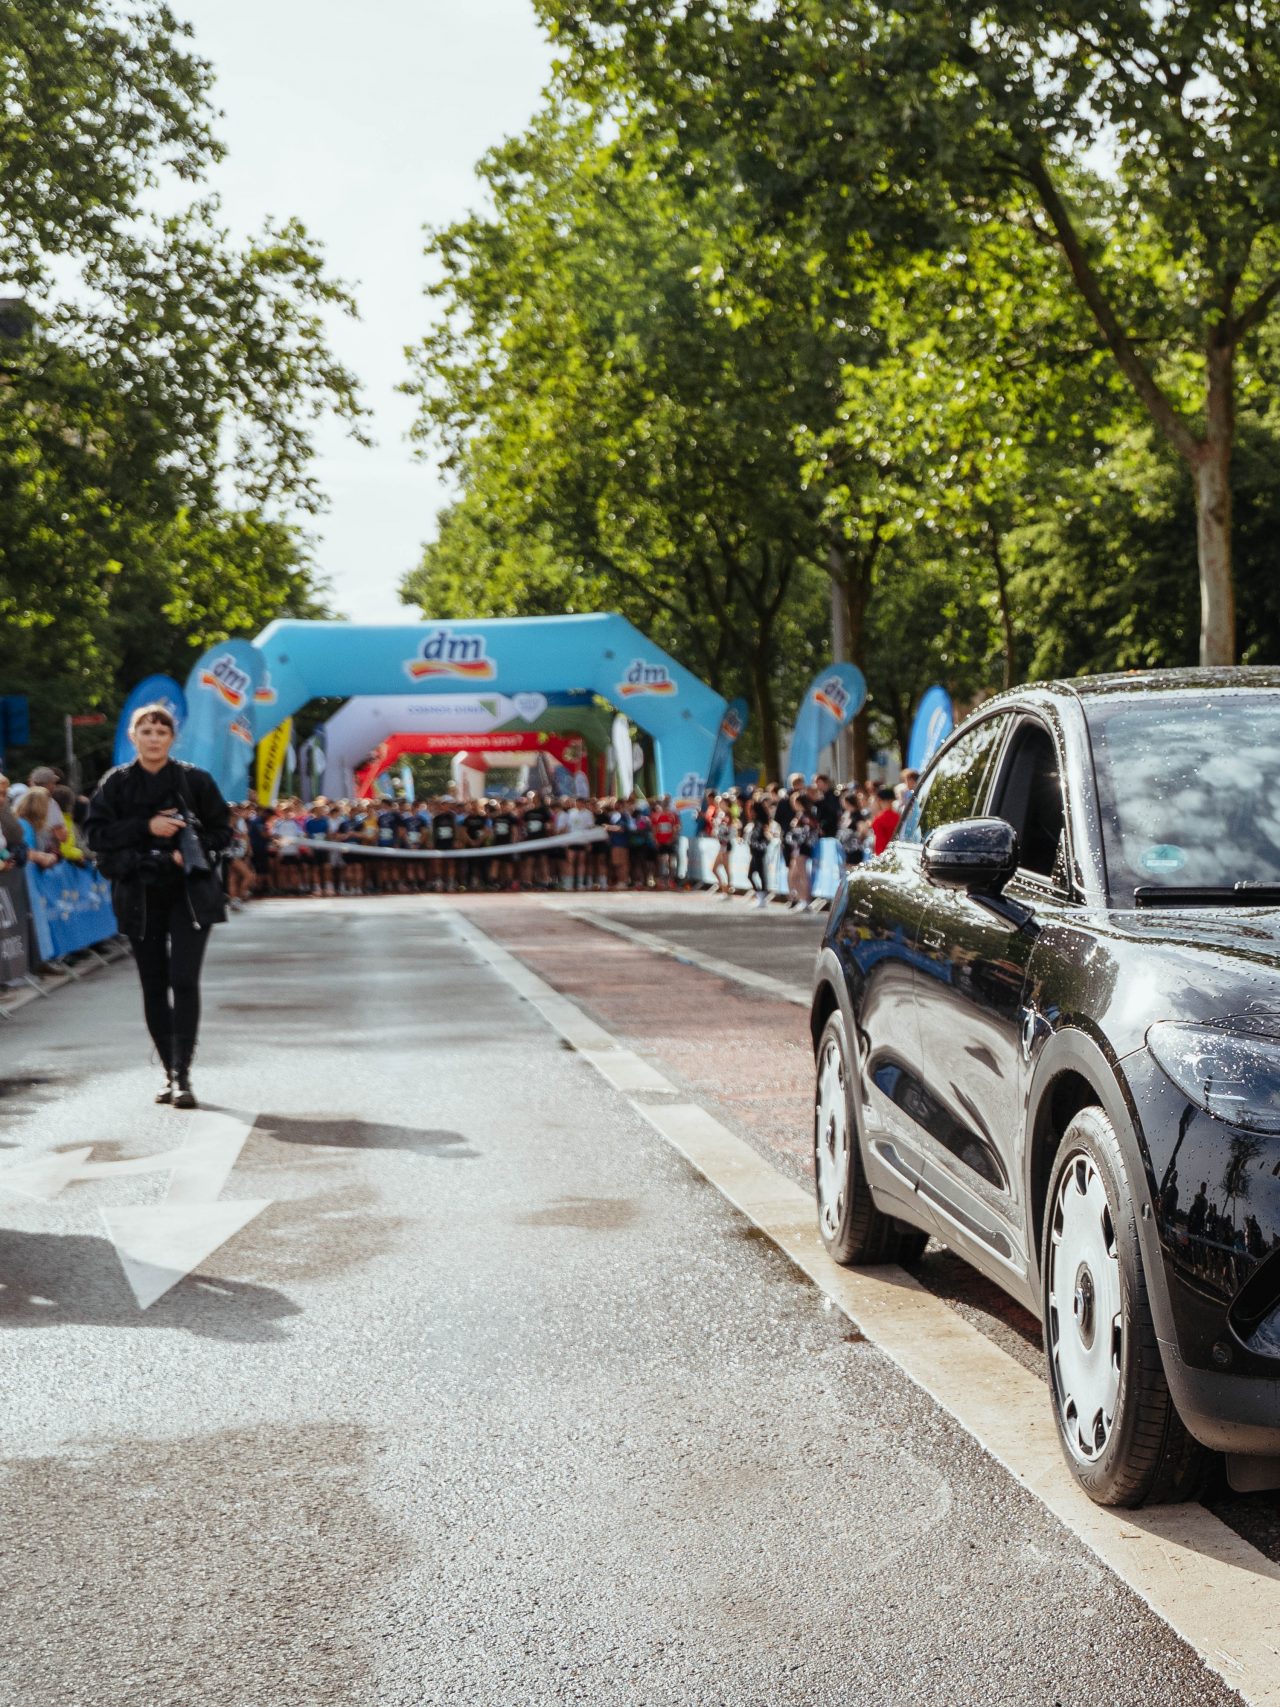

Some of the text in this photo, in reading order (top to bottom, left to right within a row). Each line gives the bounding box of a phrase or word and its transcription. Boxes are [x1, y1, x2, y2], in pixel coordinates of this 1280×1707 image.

[424, 632, 481, 659] dm
[213, 656, 248, 691] dm
[628, 661, 667, 683] dm
